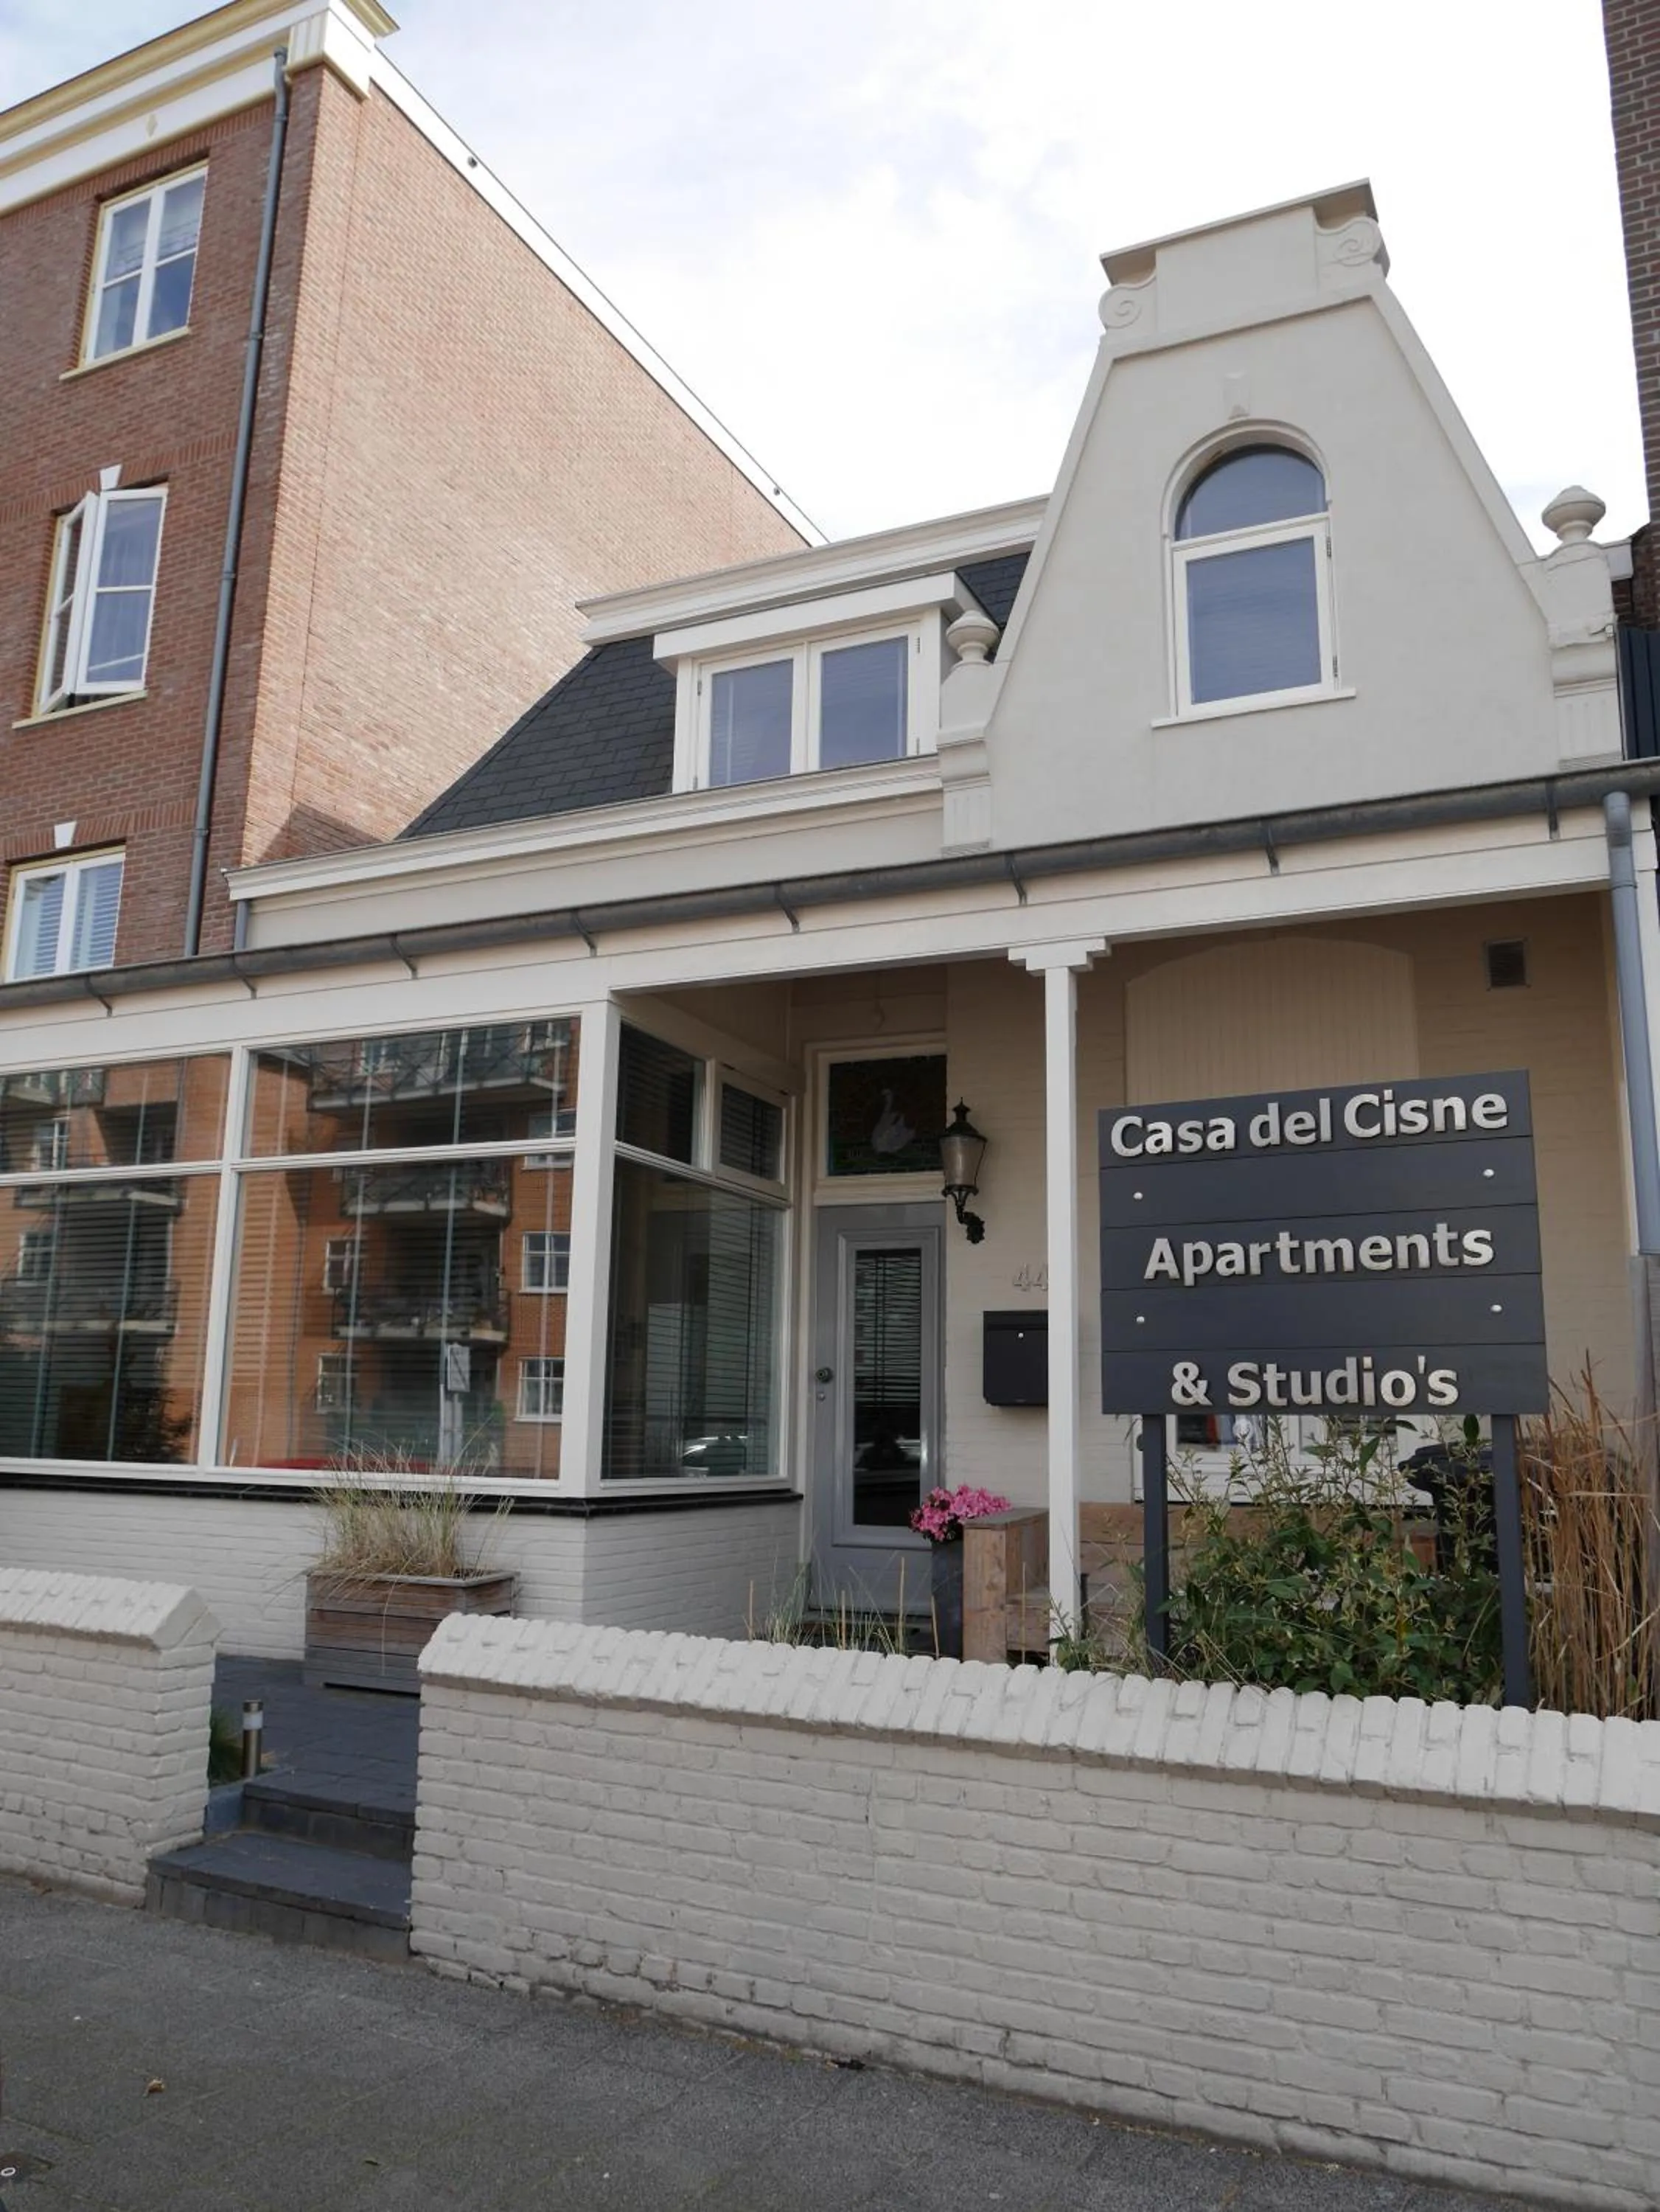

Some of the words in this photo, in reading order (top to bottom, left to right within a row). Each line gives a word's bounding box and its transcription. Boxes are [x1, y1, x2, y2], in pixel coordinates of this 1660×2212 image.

[1111, 1116, 1235, 1157] Casa
[1249, 1097, 1331, 1147] del
[1344, 1089, 1507, 1138] Cisne
[1143, 1222, 1494, 1286] Apartments
[1171, 1362, 1212, 1406] &
[1227, 1355, 1459, 1406] Studio's
